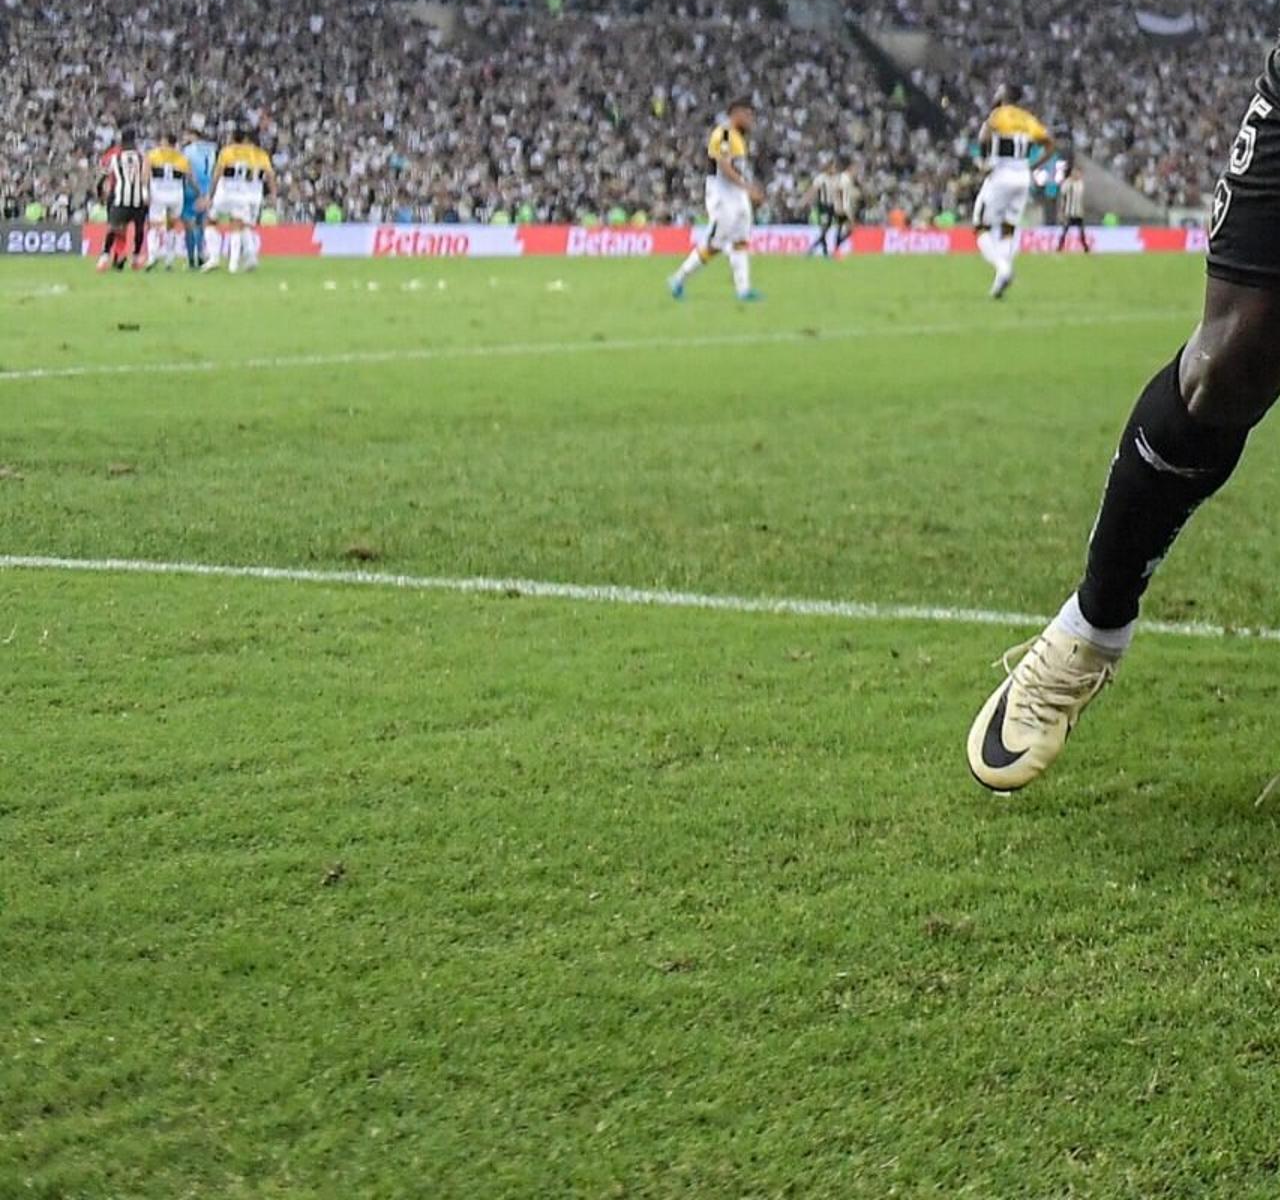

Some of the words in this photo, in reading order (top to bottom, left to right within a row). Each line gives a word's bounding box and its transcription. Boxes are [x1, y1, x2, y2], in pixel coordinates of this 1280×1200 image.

[8, 230, 72, 253] 2024
[372, 225, 470, 256] Betano
[566, 227, 653, 256] Betano
[749, 229, 808, 253] etano
